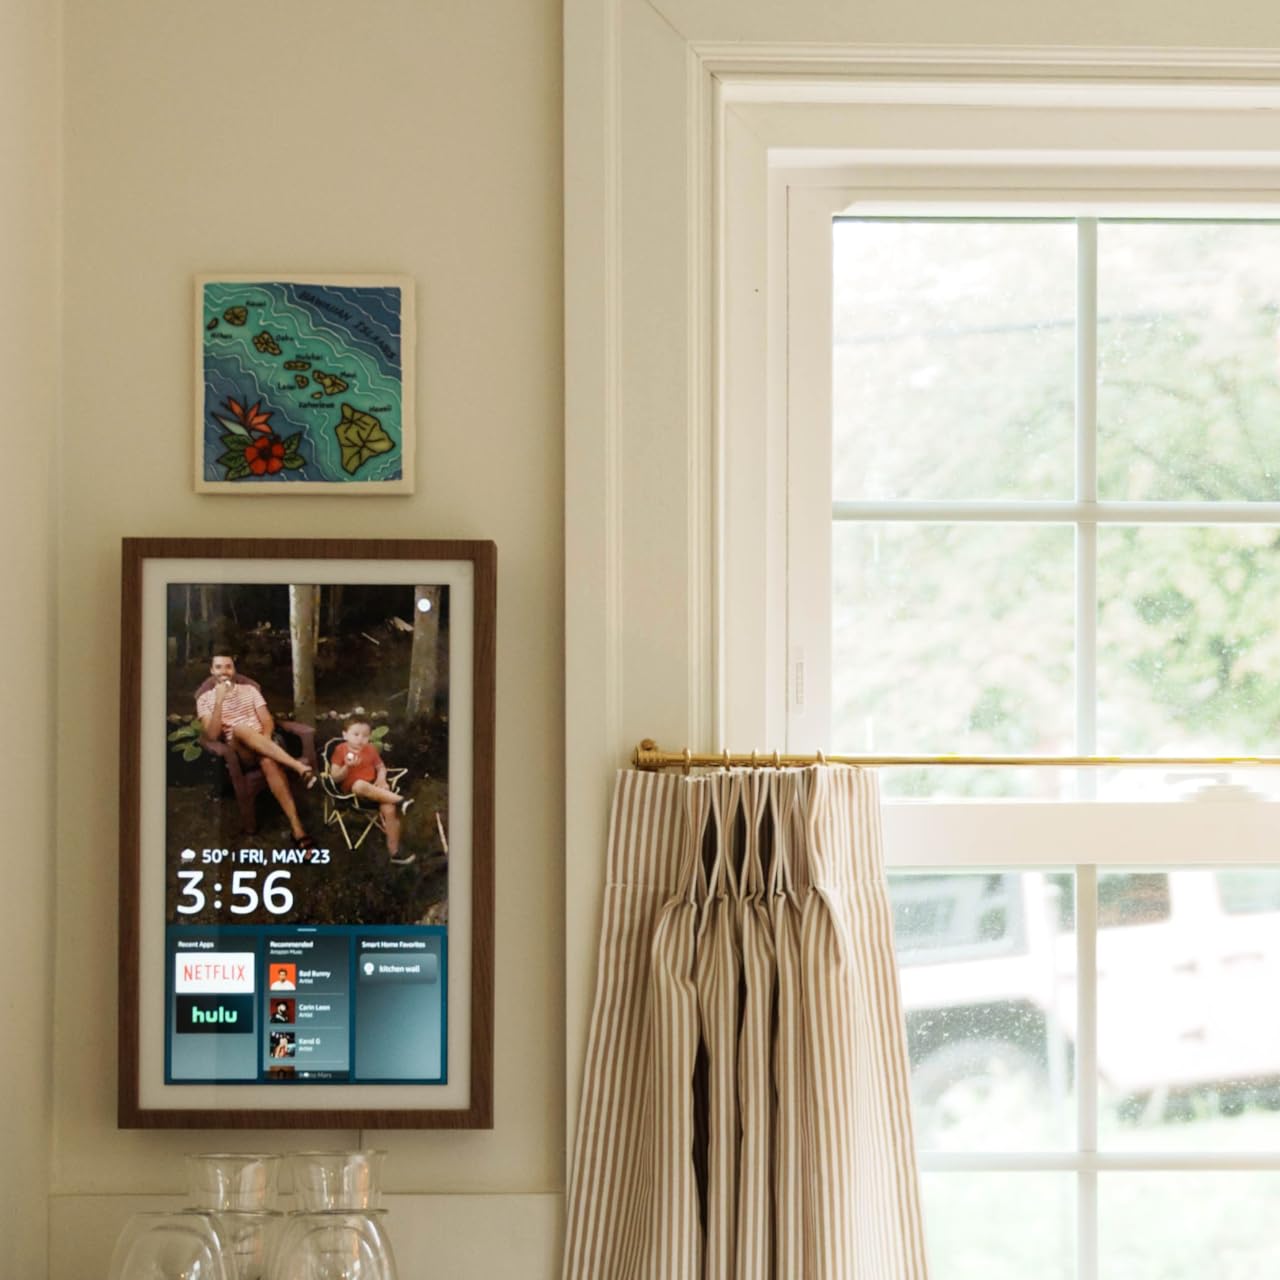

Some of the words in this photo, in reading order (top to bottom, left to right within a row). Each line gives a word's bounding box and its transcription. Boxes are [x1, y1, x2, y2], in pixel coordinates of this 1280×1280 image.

[202, 849, 229, 863] 50°
[239, 849, 268, 865] FRI,
[272, 849, 306, 863] MAY
[310, 849, 330, 863] 23
[177, 870, 293, 914] 3:56
[184, 965, 245, 981] NETFLIX
[192, 1006, 237, 1023] hulu
